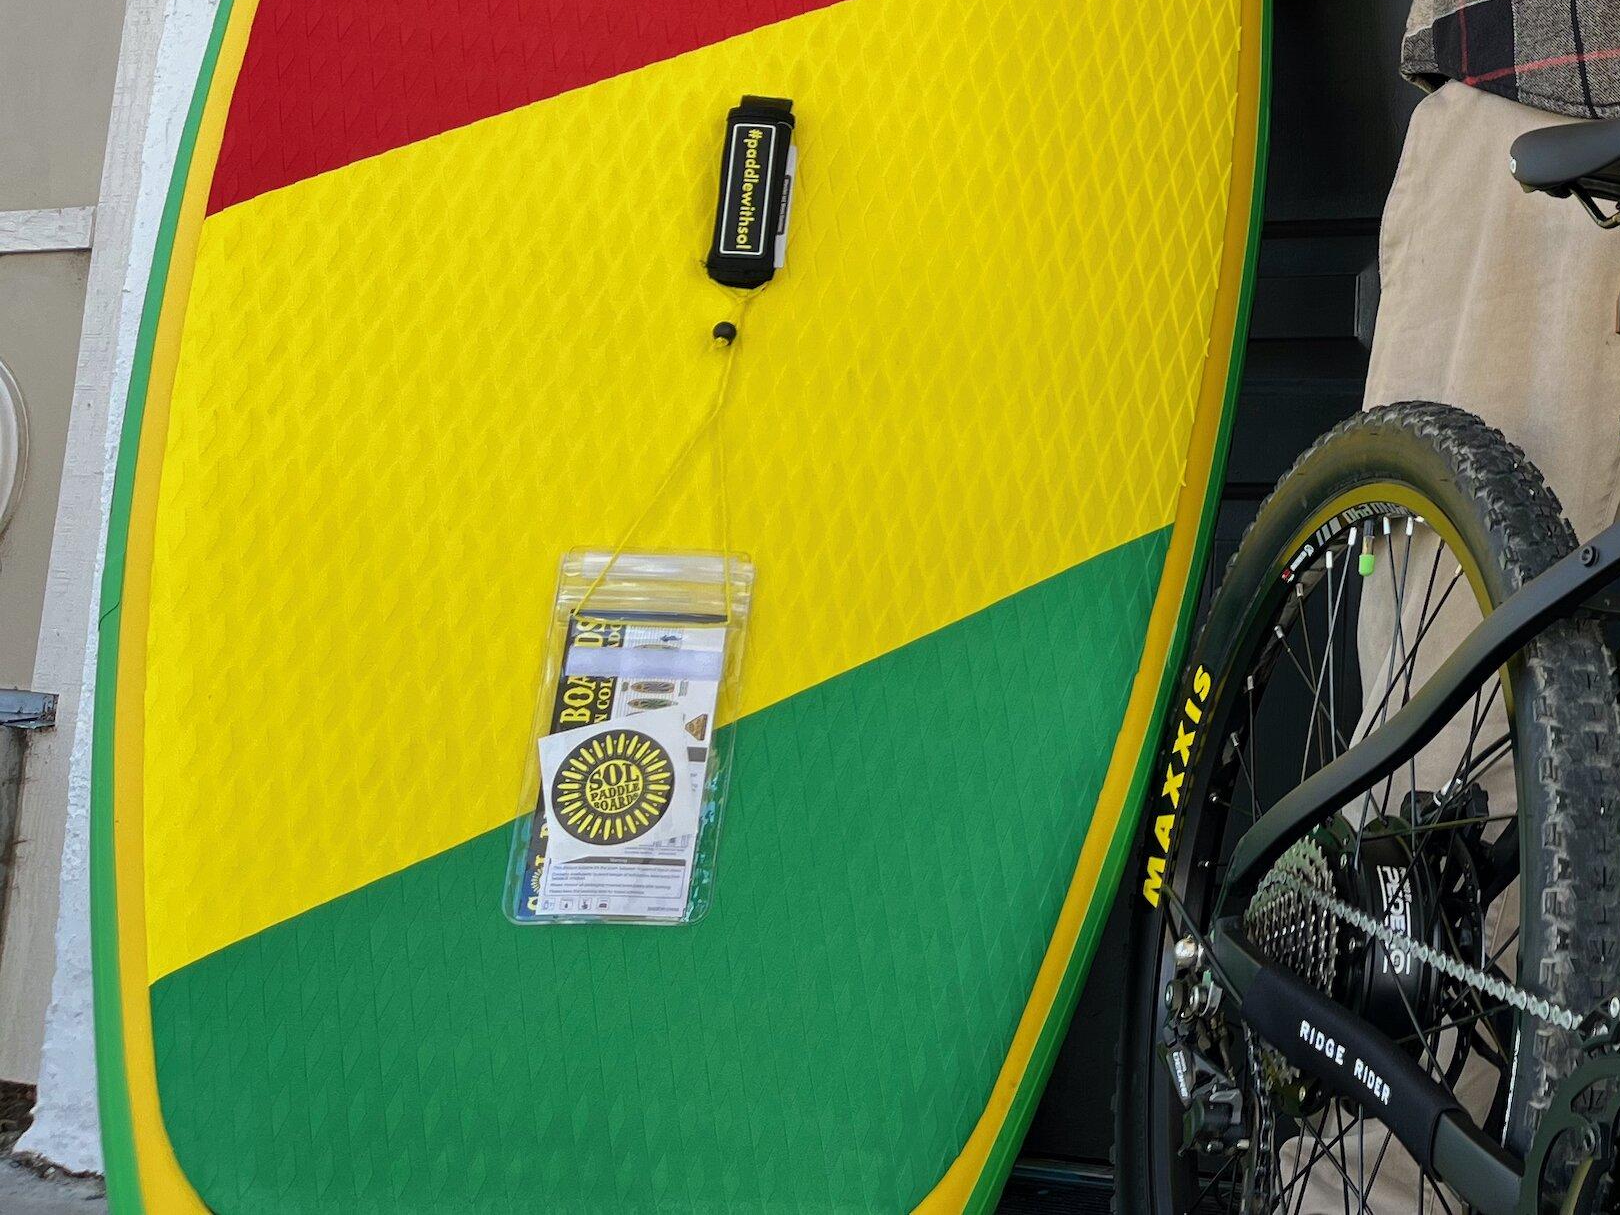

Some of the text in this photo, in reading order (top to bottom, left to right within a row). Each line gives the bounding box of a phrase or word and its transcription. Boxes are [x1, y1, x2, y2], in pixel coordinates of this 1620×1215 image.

[735, 128, 764, 250] #paddlewithsol
[560, 615, 606, 724] BOADS
[588, 761, 641, 792] SOL
[590, 782, 640, 803] PADDLE
[1142, 664, 1212, 909] MAXXIS
[593, 791, 639, 812] BOARDS
[1382, 865, 1405, 975] PEDEO
[1299, 1019, 1346, 1066] RIDGE
[1353, 1058, 1393, 1106] RIDER
